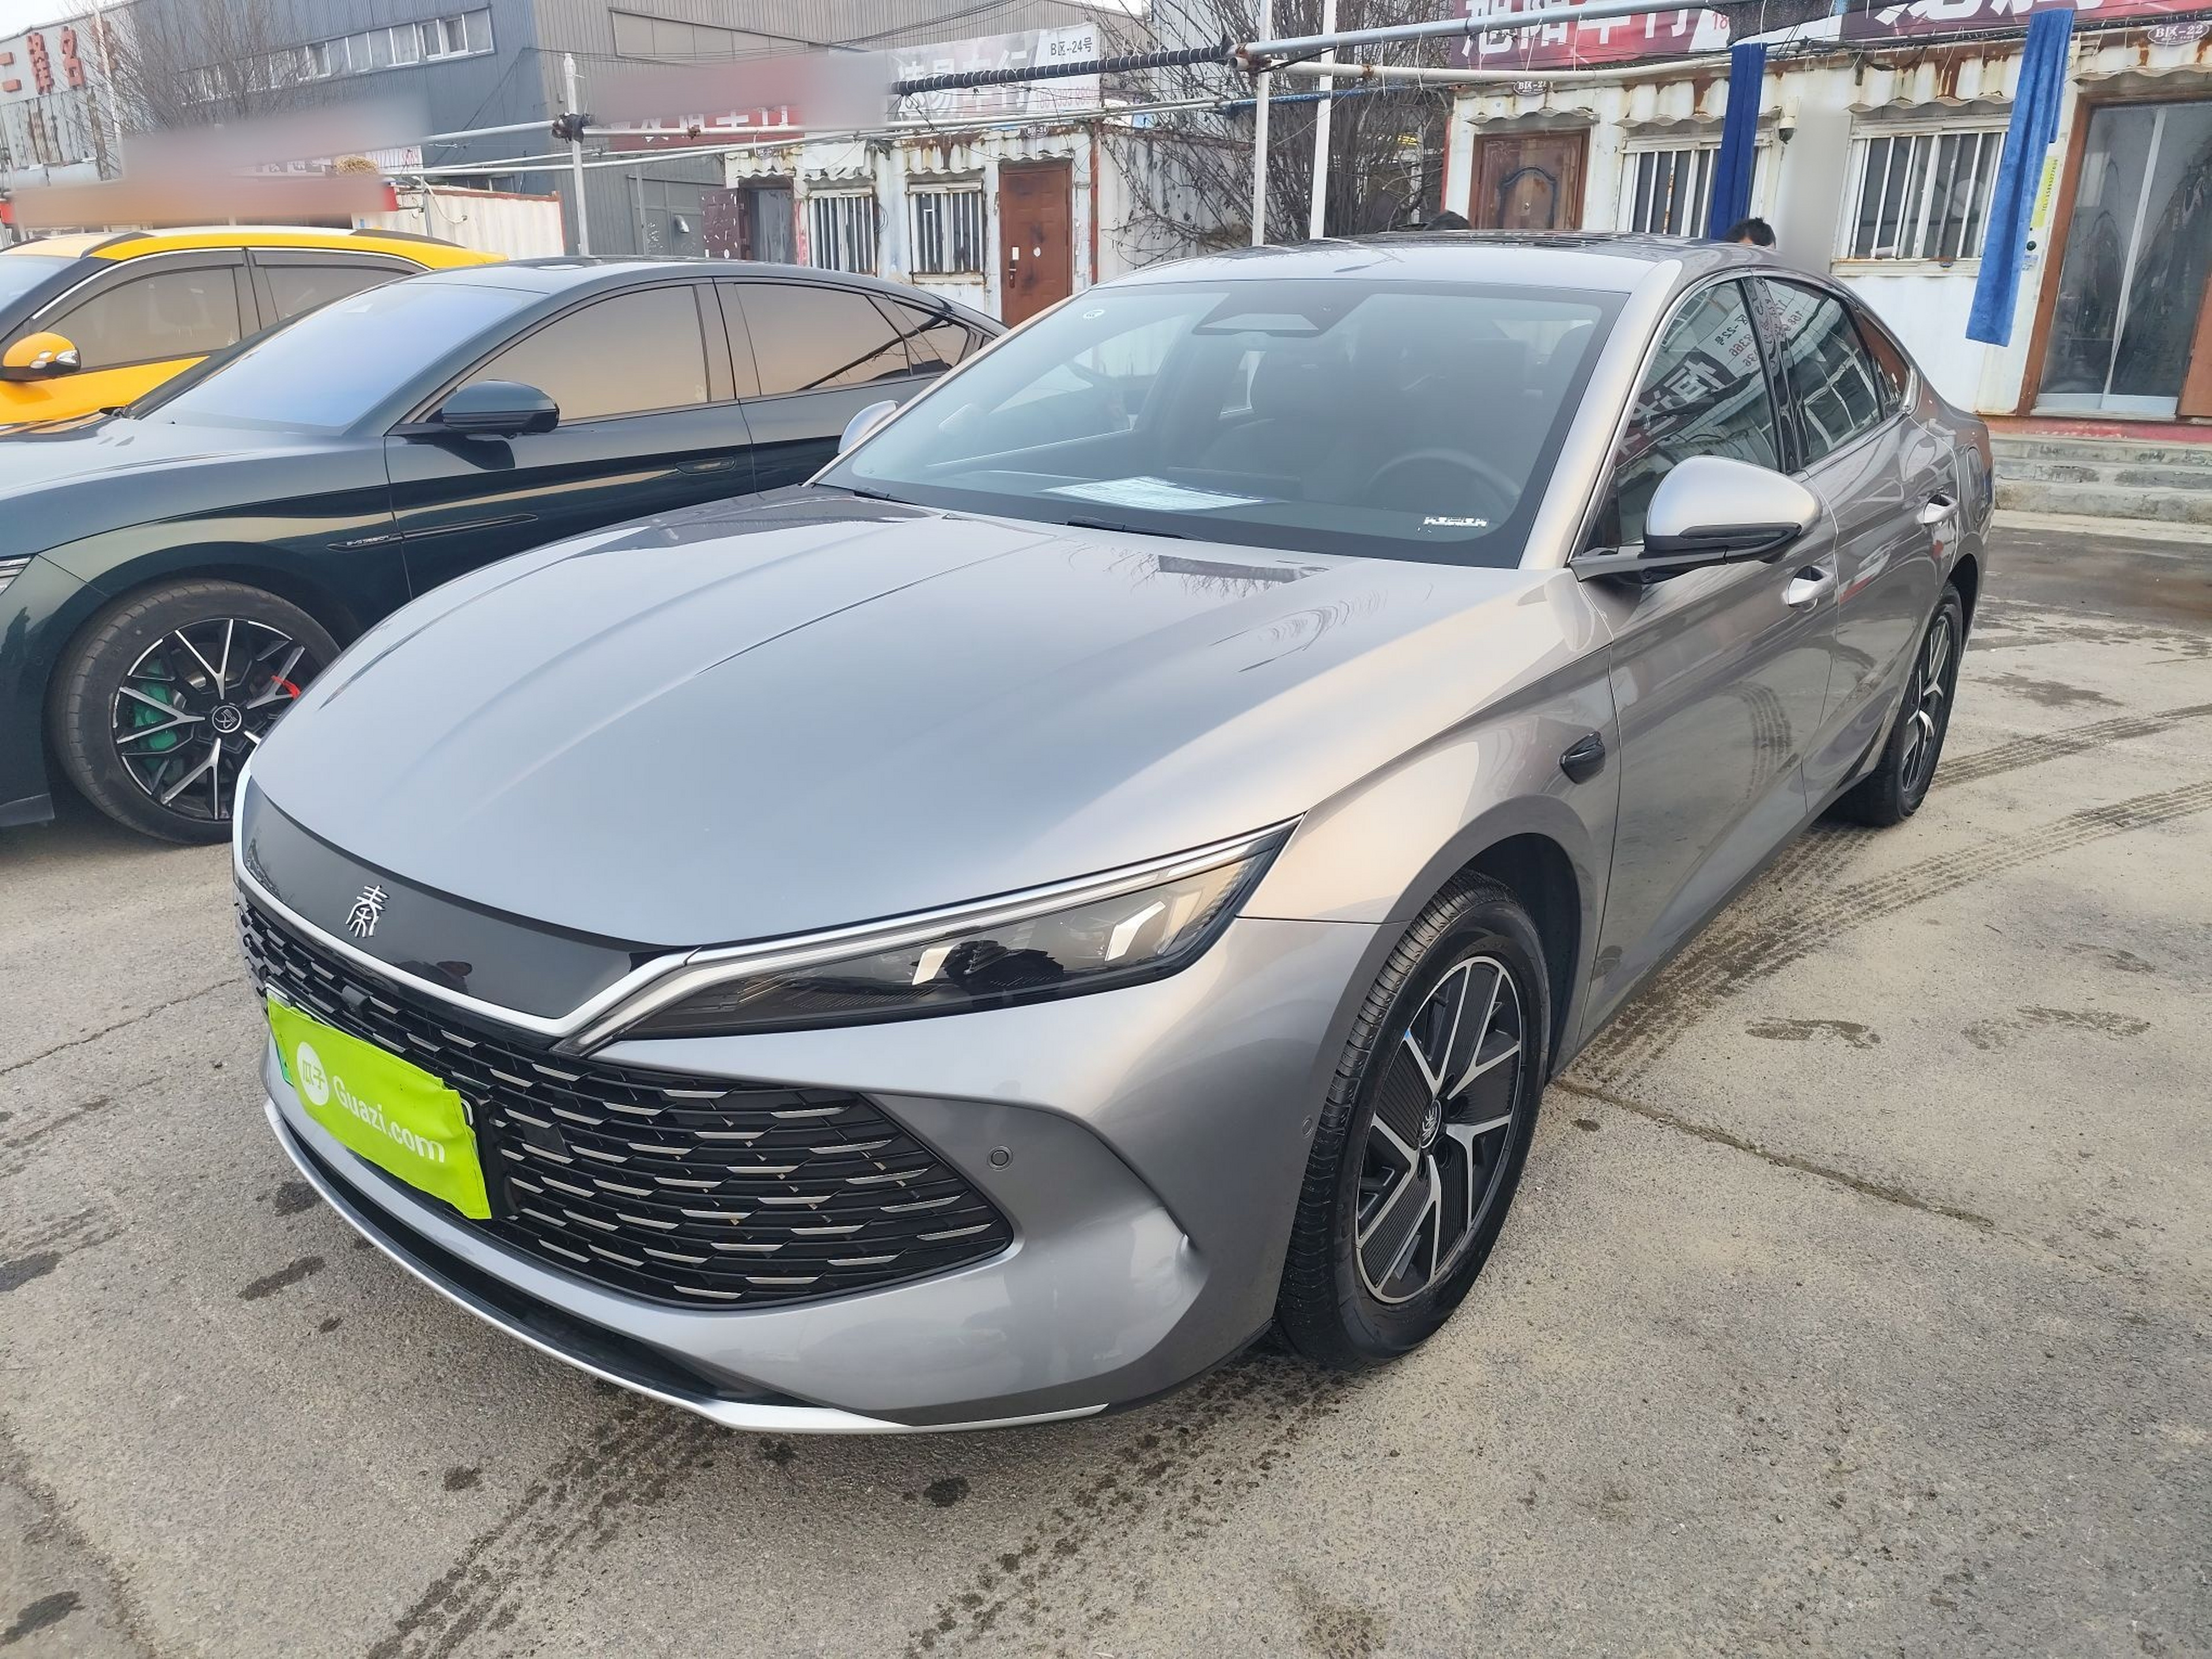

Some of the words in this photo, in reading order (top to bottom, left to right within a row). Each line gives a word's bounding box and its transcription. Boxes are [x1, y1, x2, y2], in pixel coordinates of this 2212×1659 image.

[2154, 25, 2203, 38] B区-22
[1051, 37, 1092, 56] B区-24号
[303, 1060, 325, 1090] 瓜子
[333, 1075, 445, 1162] Guazi.com
